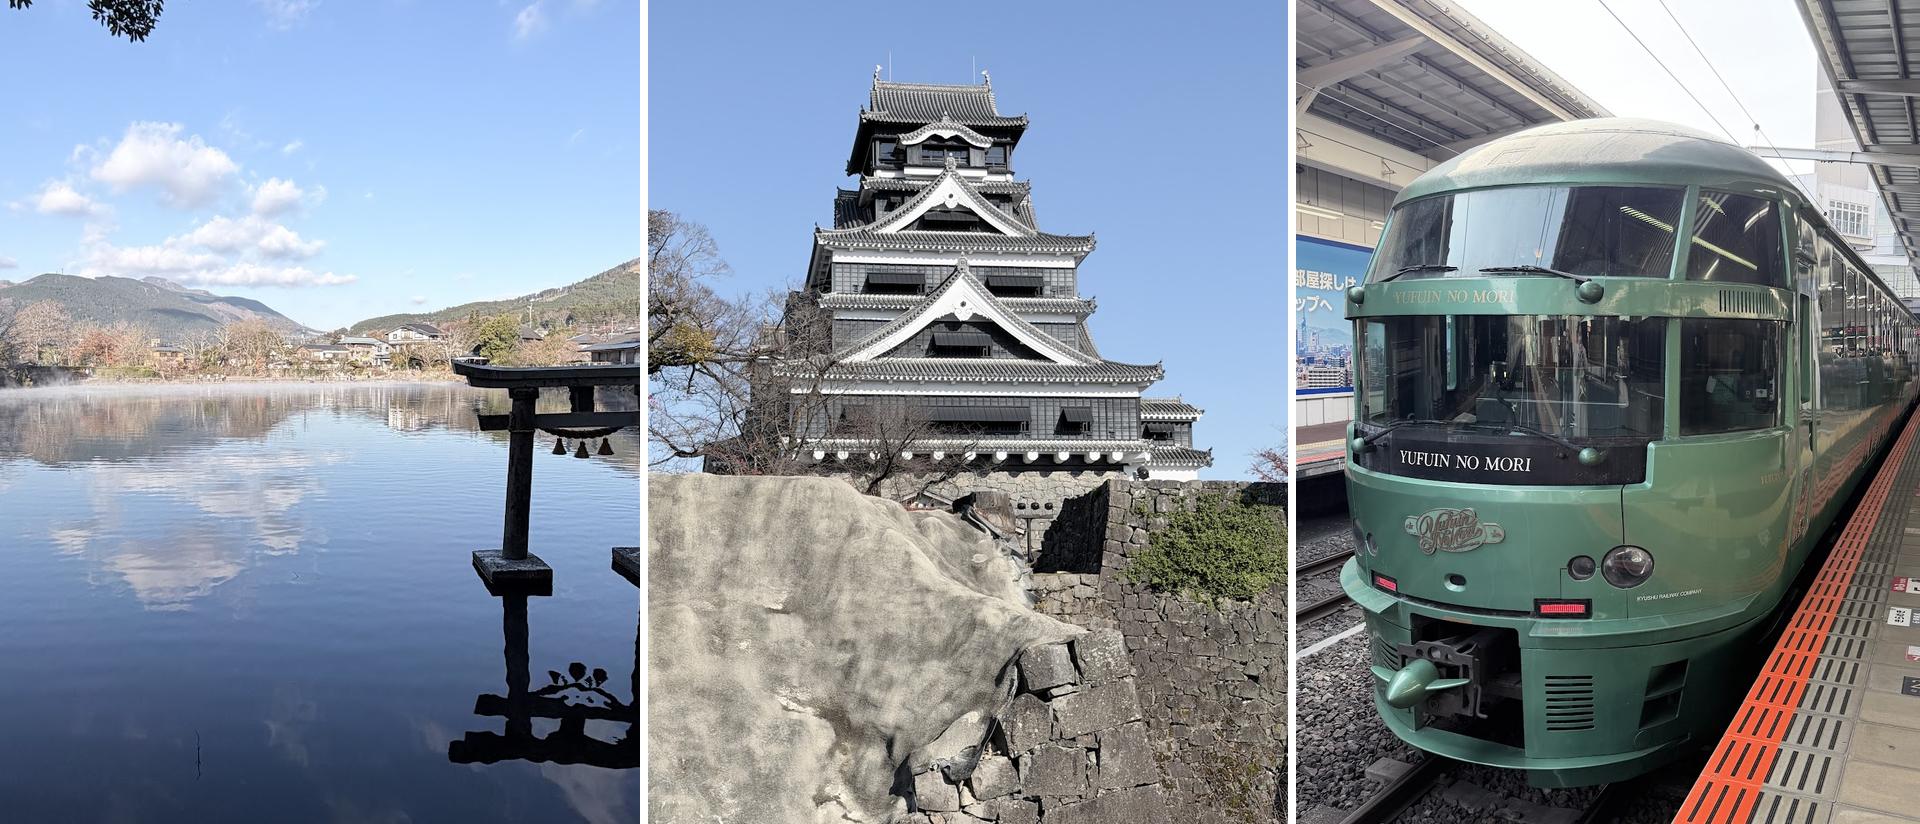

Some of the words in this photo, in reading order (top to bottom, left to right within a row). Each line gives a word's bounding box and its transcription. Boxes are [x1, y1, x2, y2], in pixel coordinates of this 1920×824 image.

[1393, 289, 1441, 304] YUFUIN
[1448, 289, 1468, 304] NO
[1473, 289, 1514, 304] MORI
[1400, 450, 1451, 467] YUFUIN
[1456, 455, 1479, 470] NO
[1484, 457, 1531, 472] MORI
